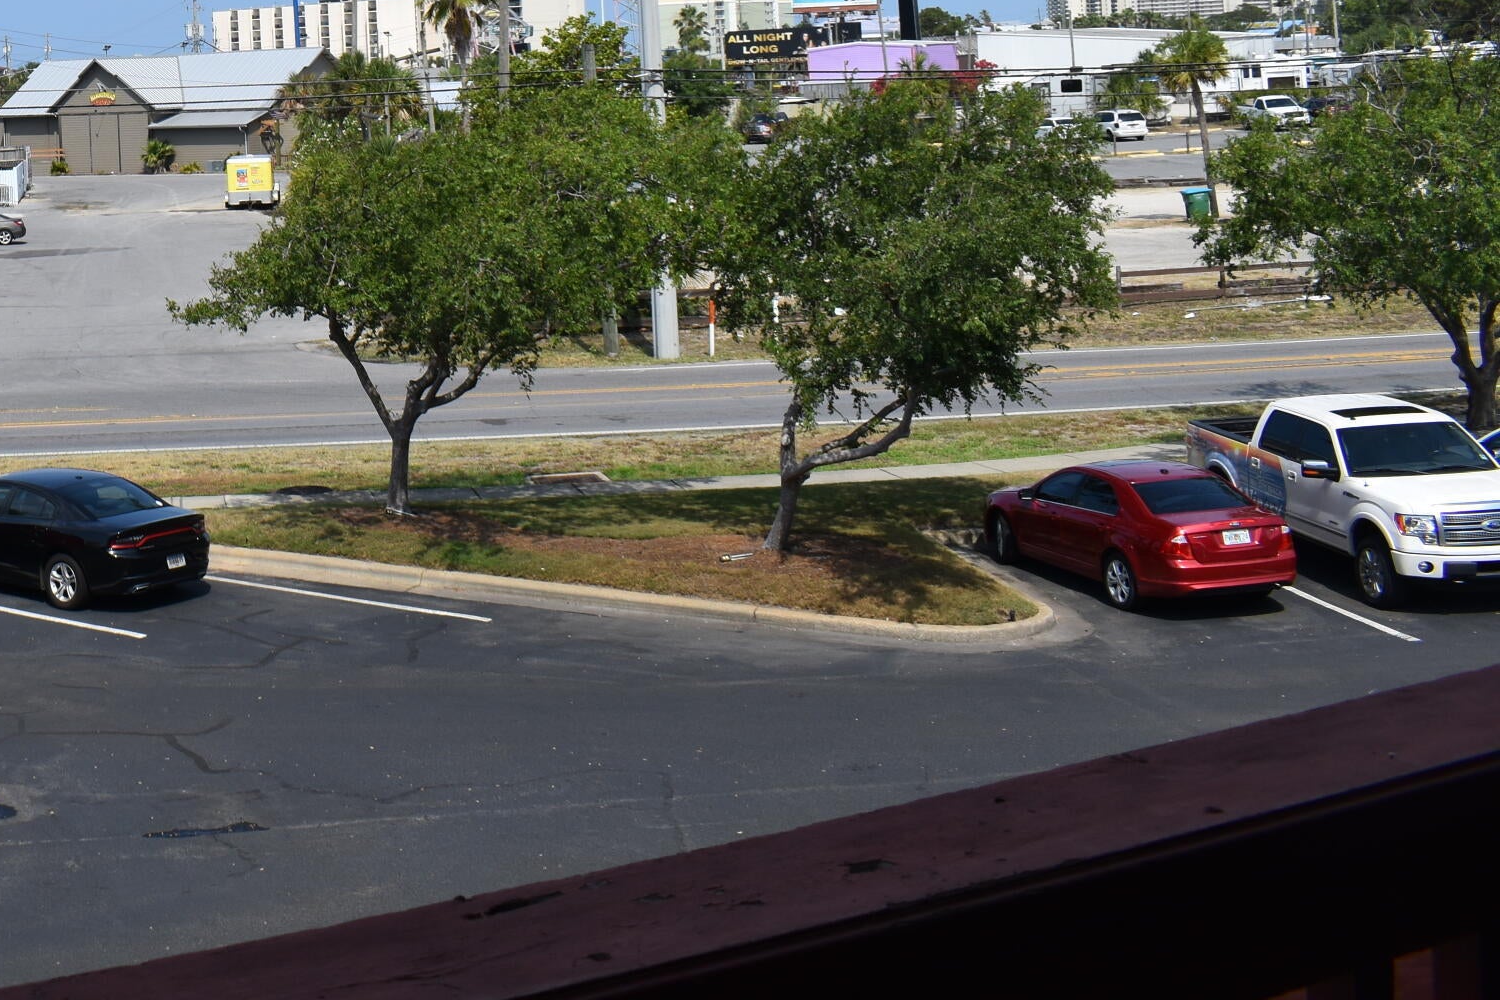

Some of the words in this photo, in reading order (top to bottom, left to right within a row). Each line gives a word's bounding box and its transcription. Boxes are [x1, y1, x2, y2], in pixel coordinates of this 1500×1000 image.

[728, 34, 750, 43] ALL
[753, 32, 792, 42] NIGHT
[743, 45, 778, 54] LONG
